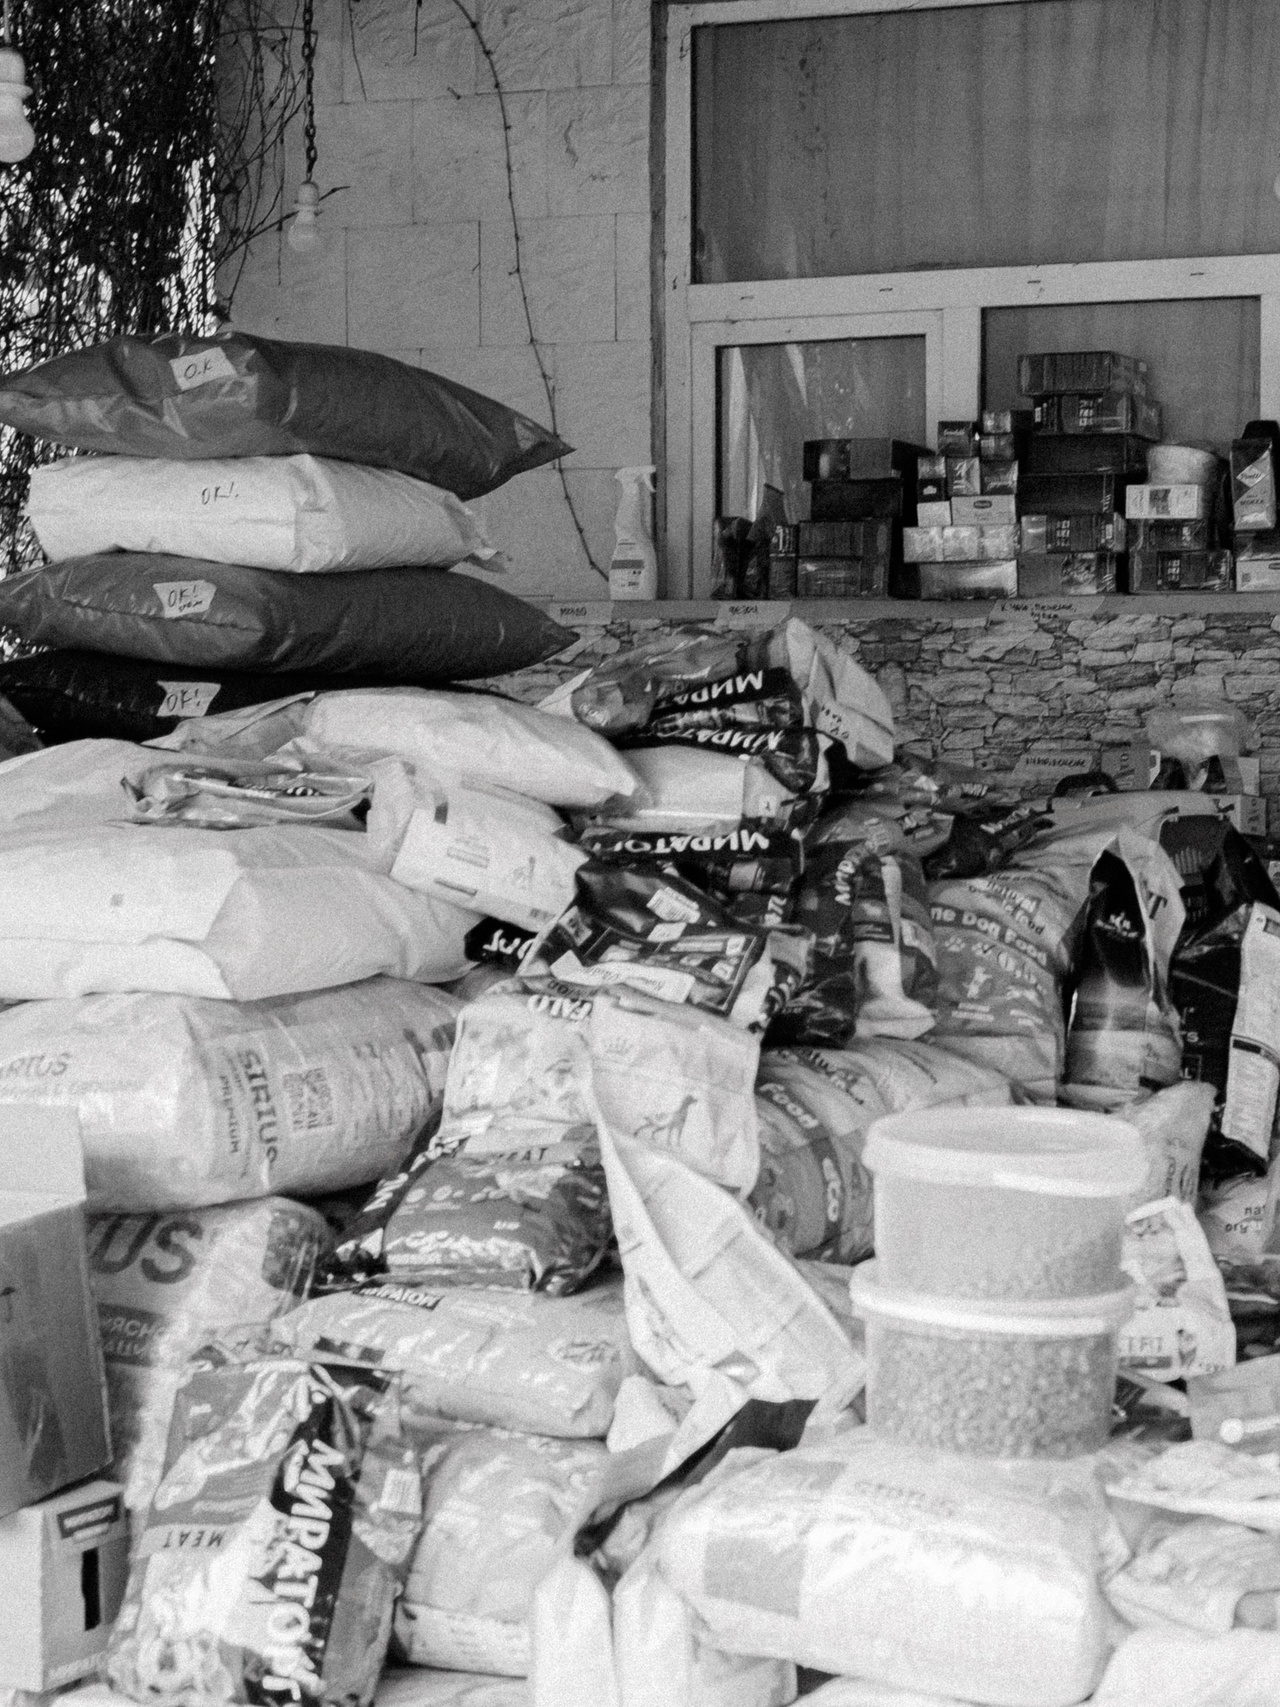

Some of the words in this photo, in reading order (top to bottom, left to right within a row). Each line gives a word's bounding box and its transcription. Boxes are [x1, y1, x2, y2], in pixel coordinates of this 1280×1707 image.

[167, 688, 201, 712] OK!
[962, 911, 1000, 940] Dog
[163, 1530, 226, 1547] MEAT
